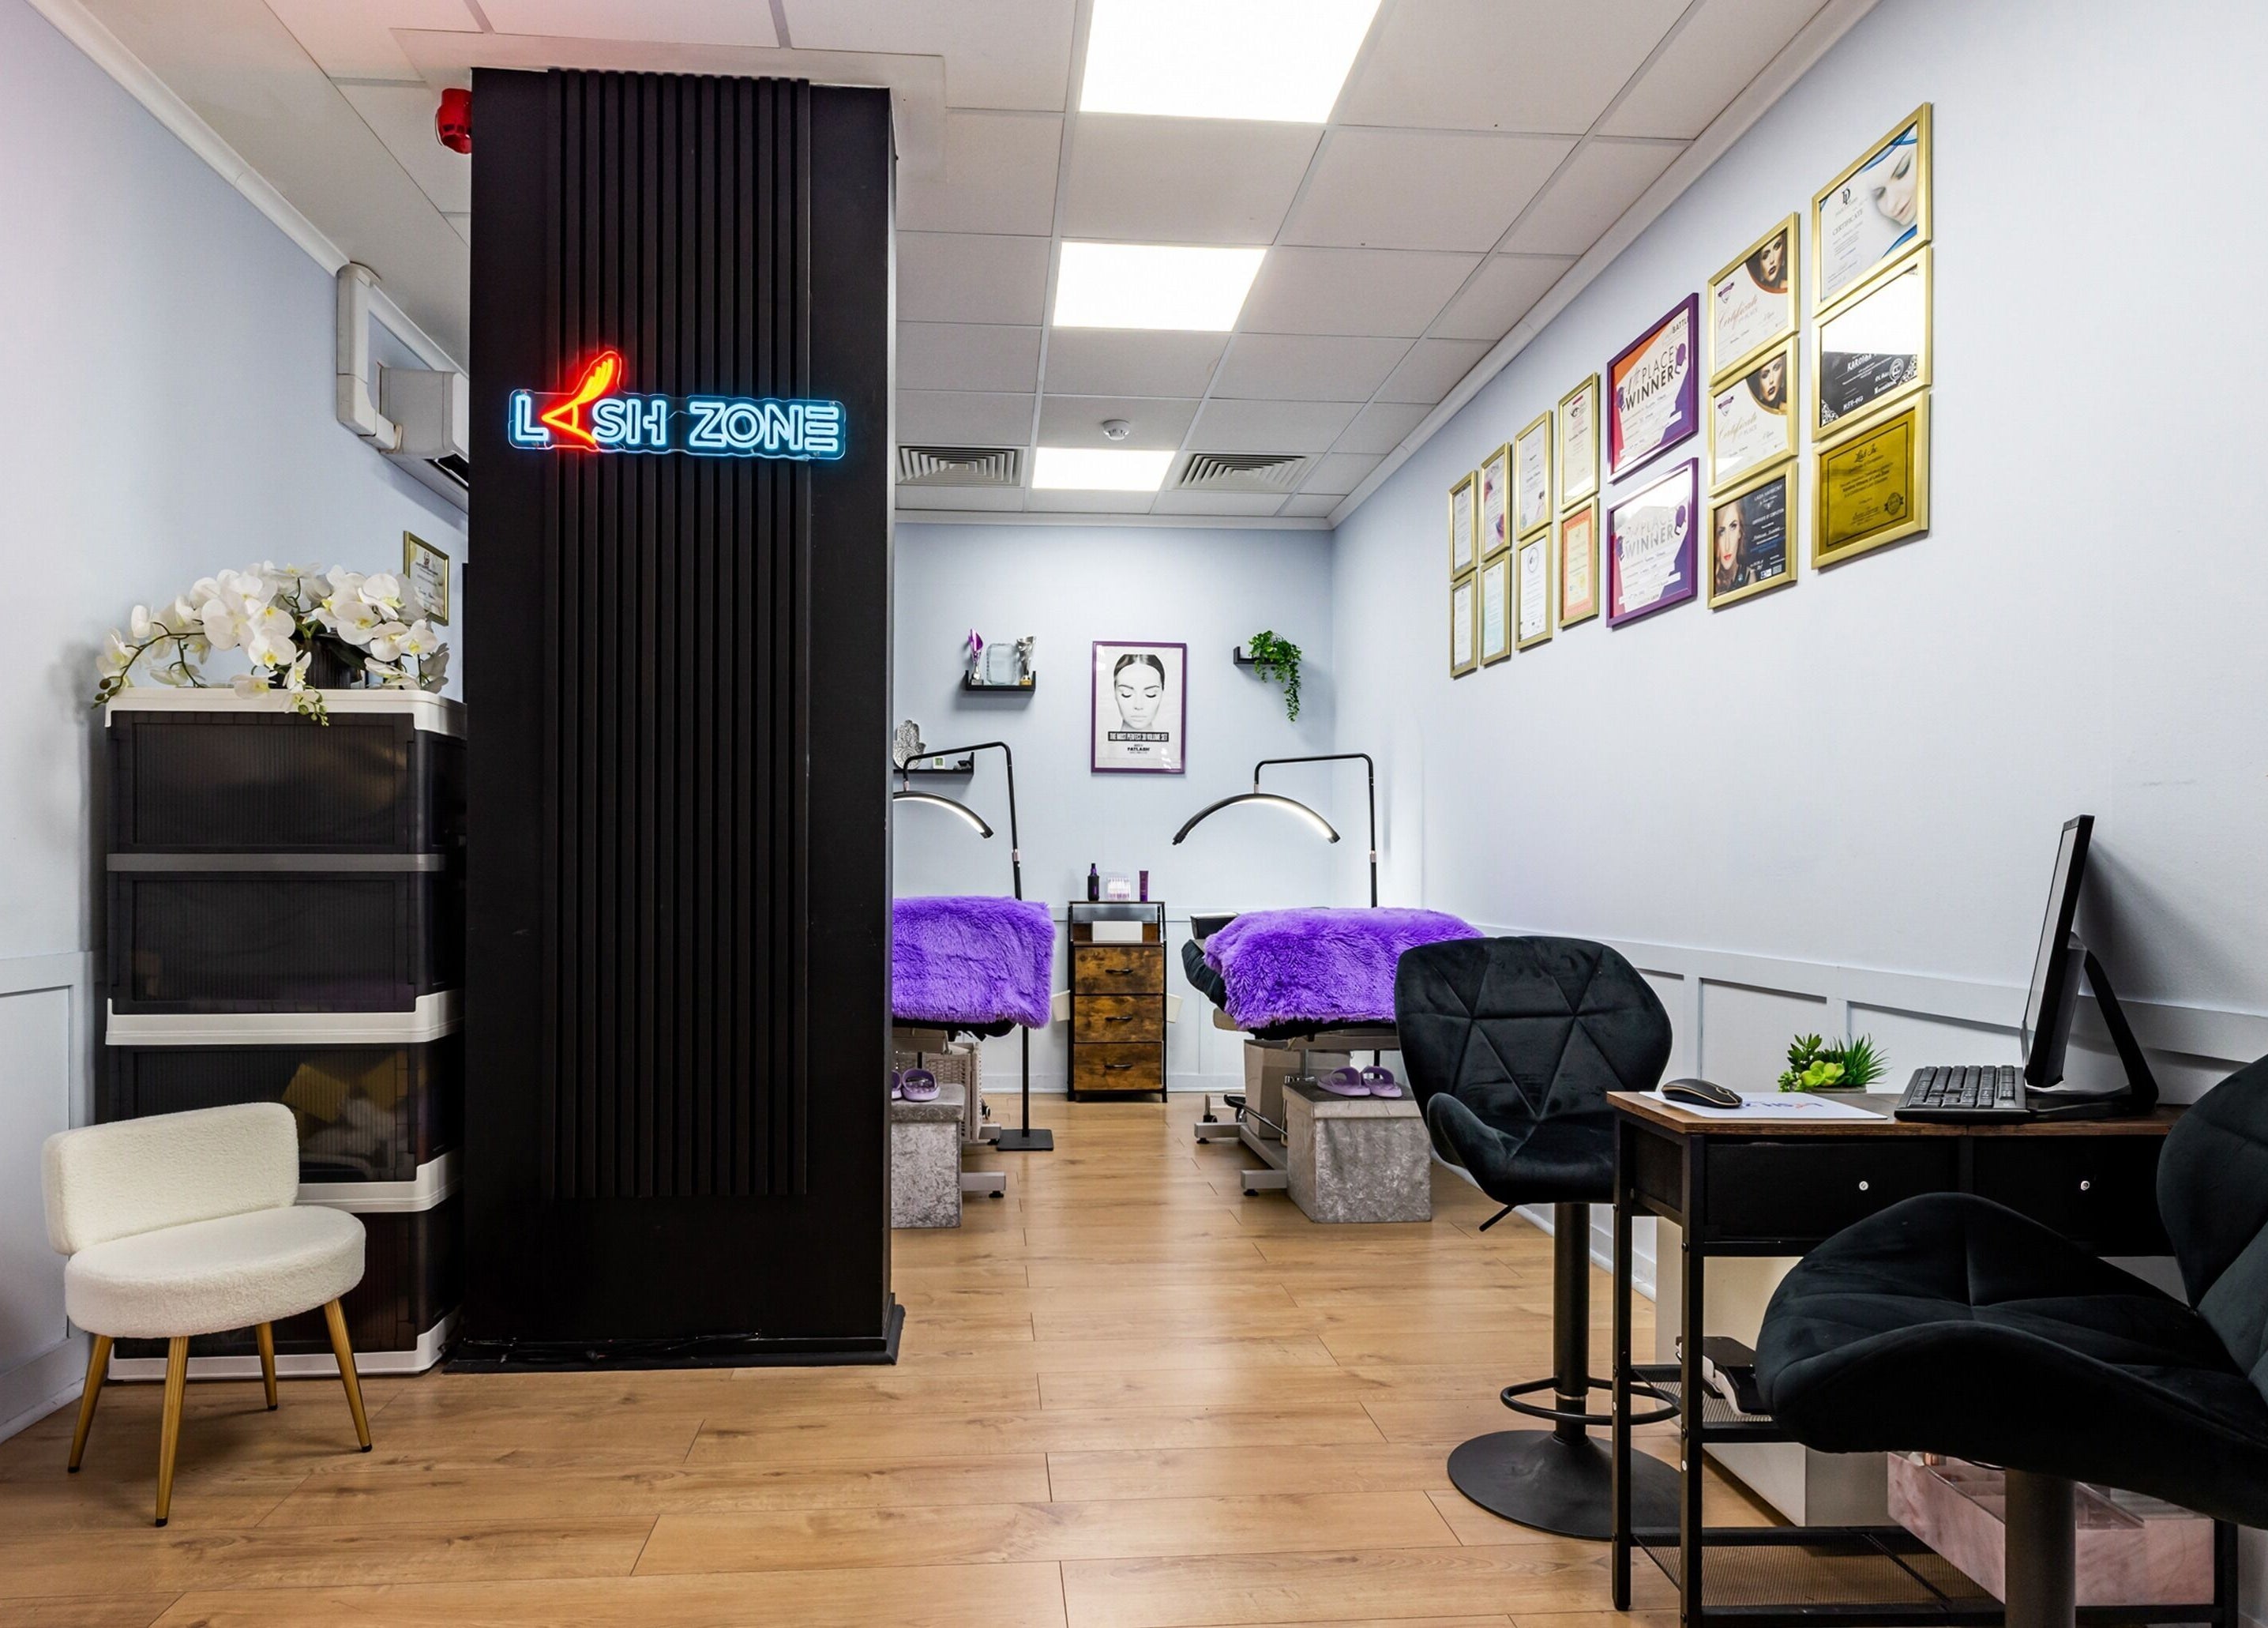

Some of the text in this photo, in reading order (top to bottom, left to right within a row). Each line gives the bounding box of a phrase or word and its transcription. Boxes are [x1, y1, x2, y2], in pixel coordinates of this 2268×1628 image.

[1643, 346, 1674, 384] PLACE
[515, 359, 839, 451] LASH ZONE
[1626, 365, 1674, 411] WINNER
[1626, 524, 1674, 559] WINNER
